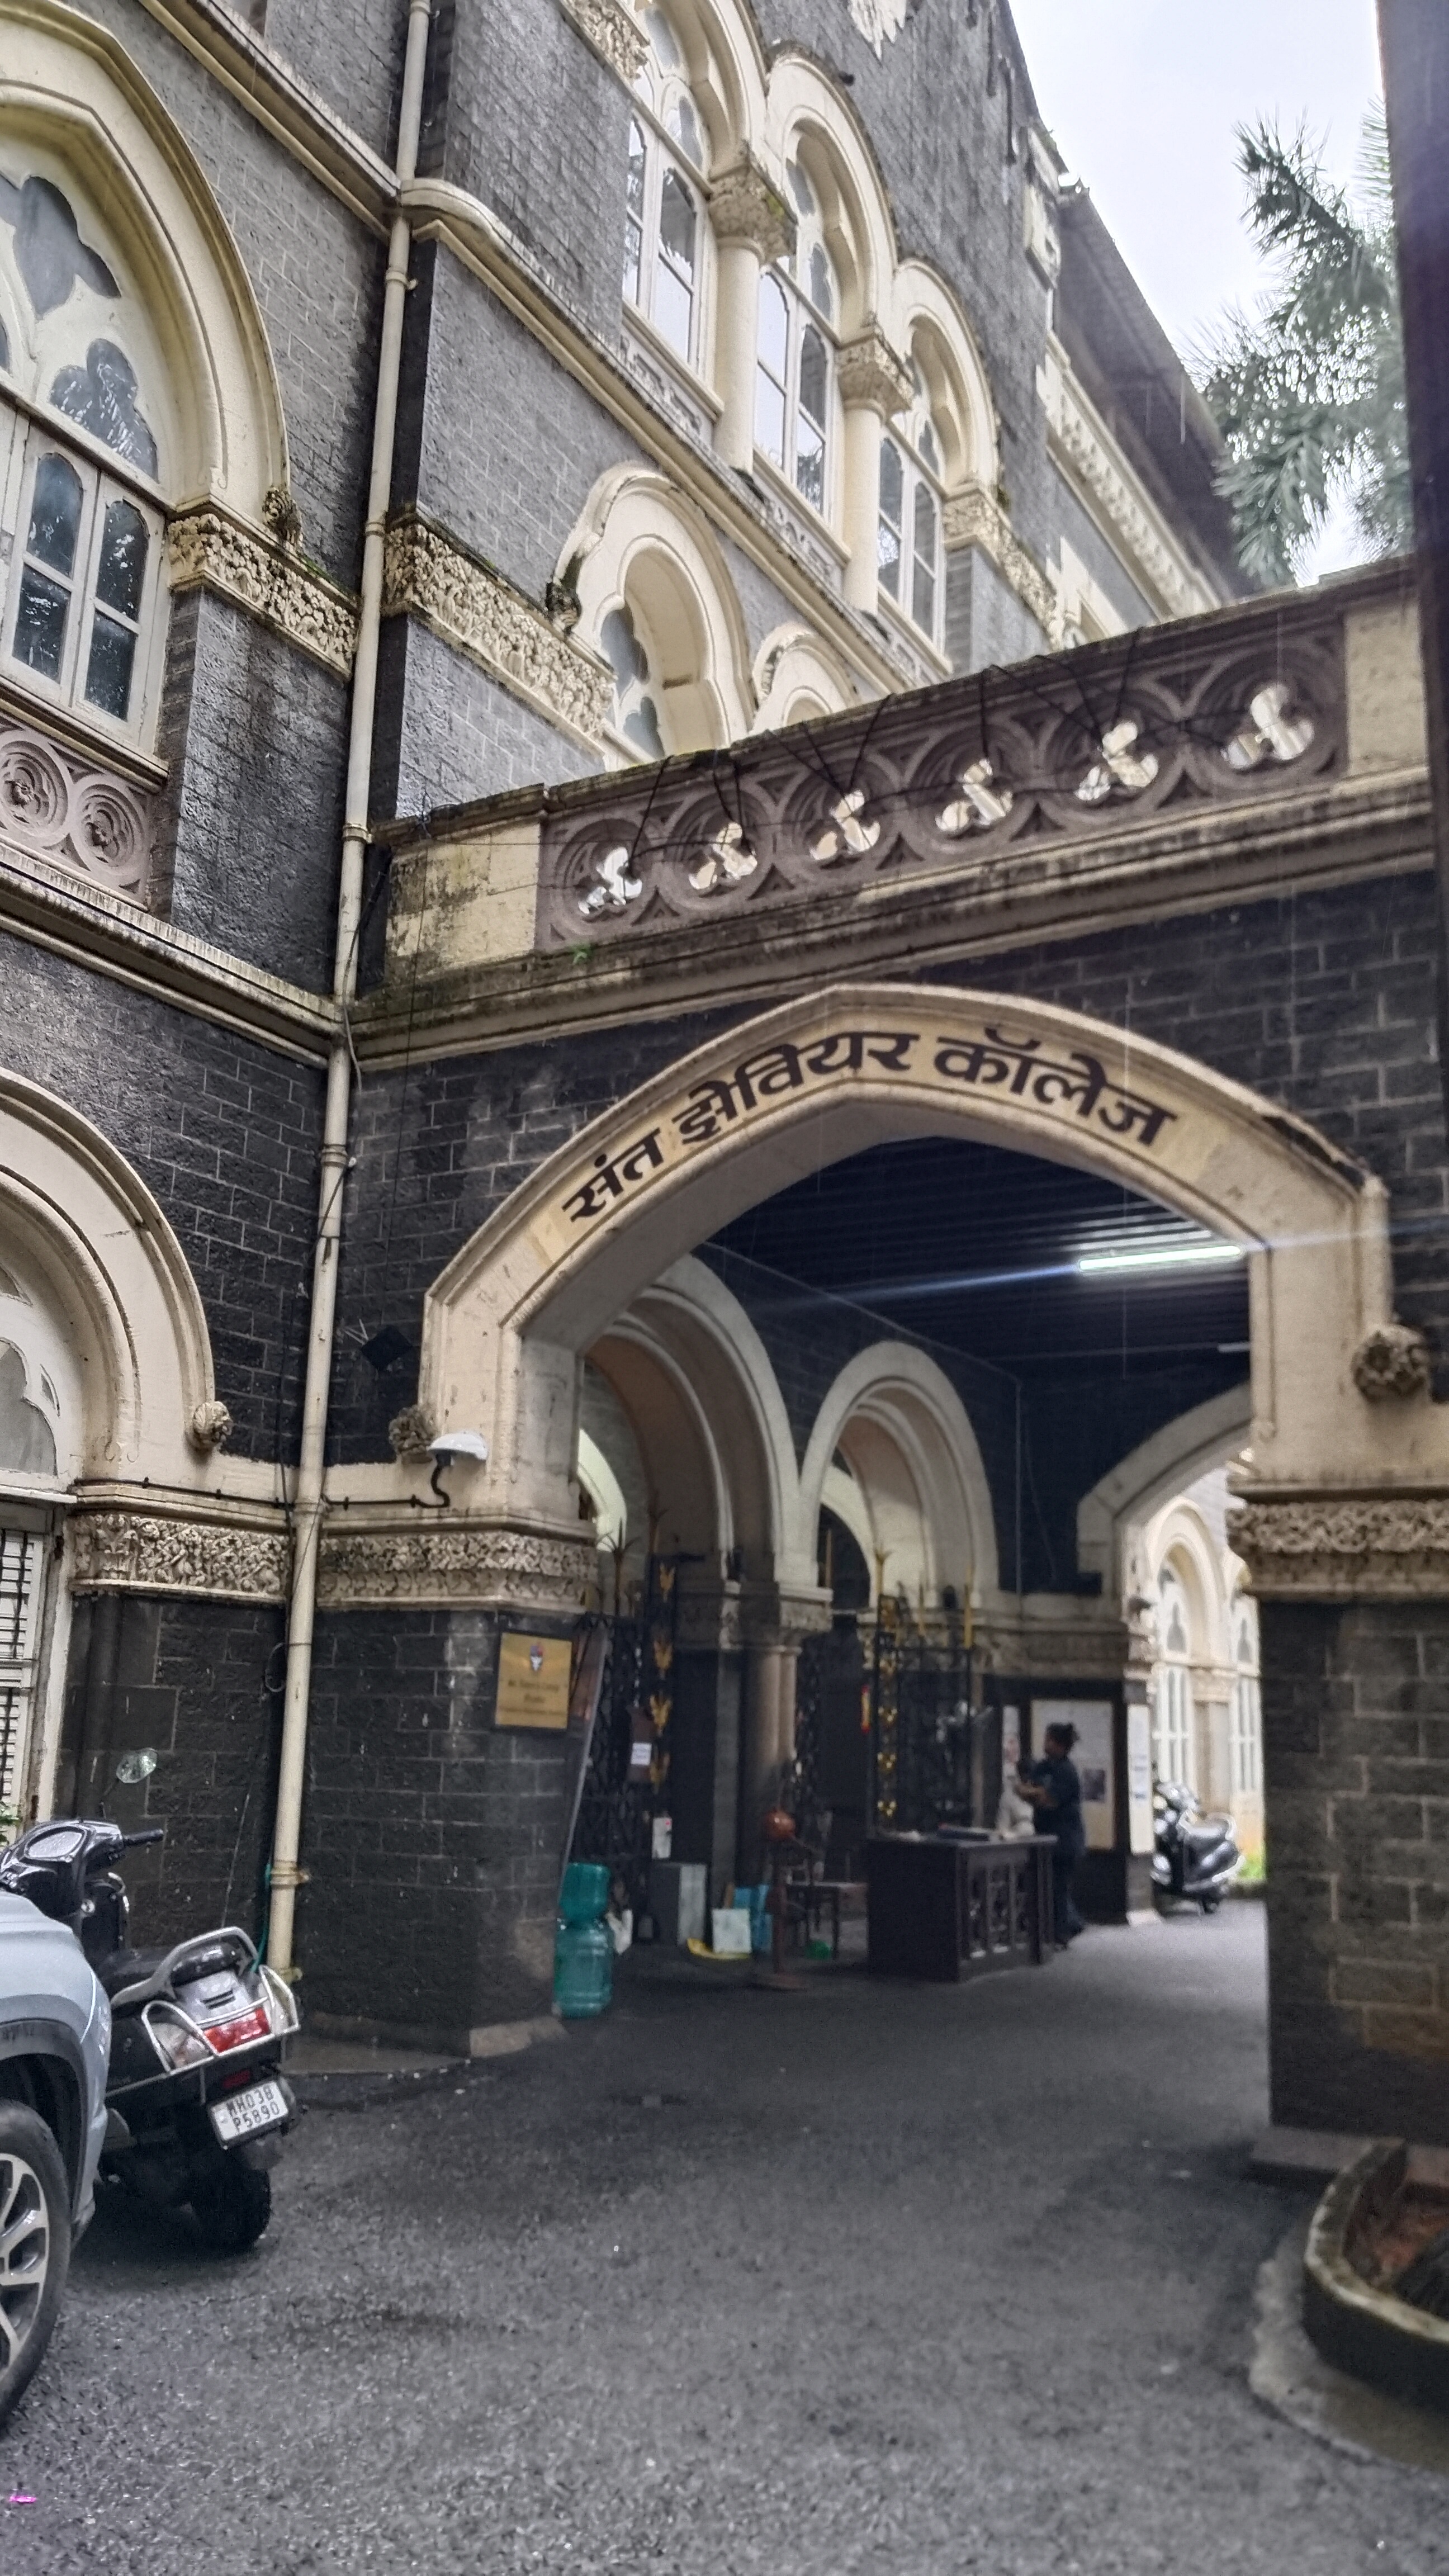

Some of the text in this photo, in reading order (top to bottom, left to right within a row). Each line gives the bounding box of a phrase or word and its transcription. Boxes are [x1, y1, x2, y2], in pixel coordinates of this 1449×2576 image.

[562, 1027, 1177, 1223] संत झेवियर कॉलेज
[233, 2101, 280, 2133] P5890
